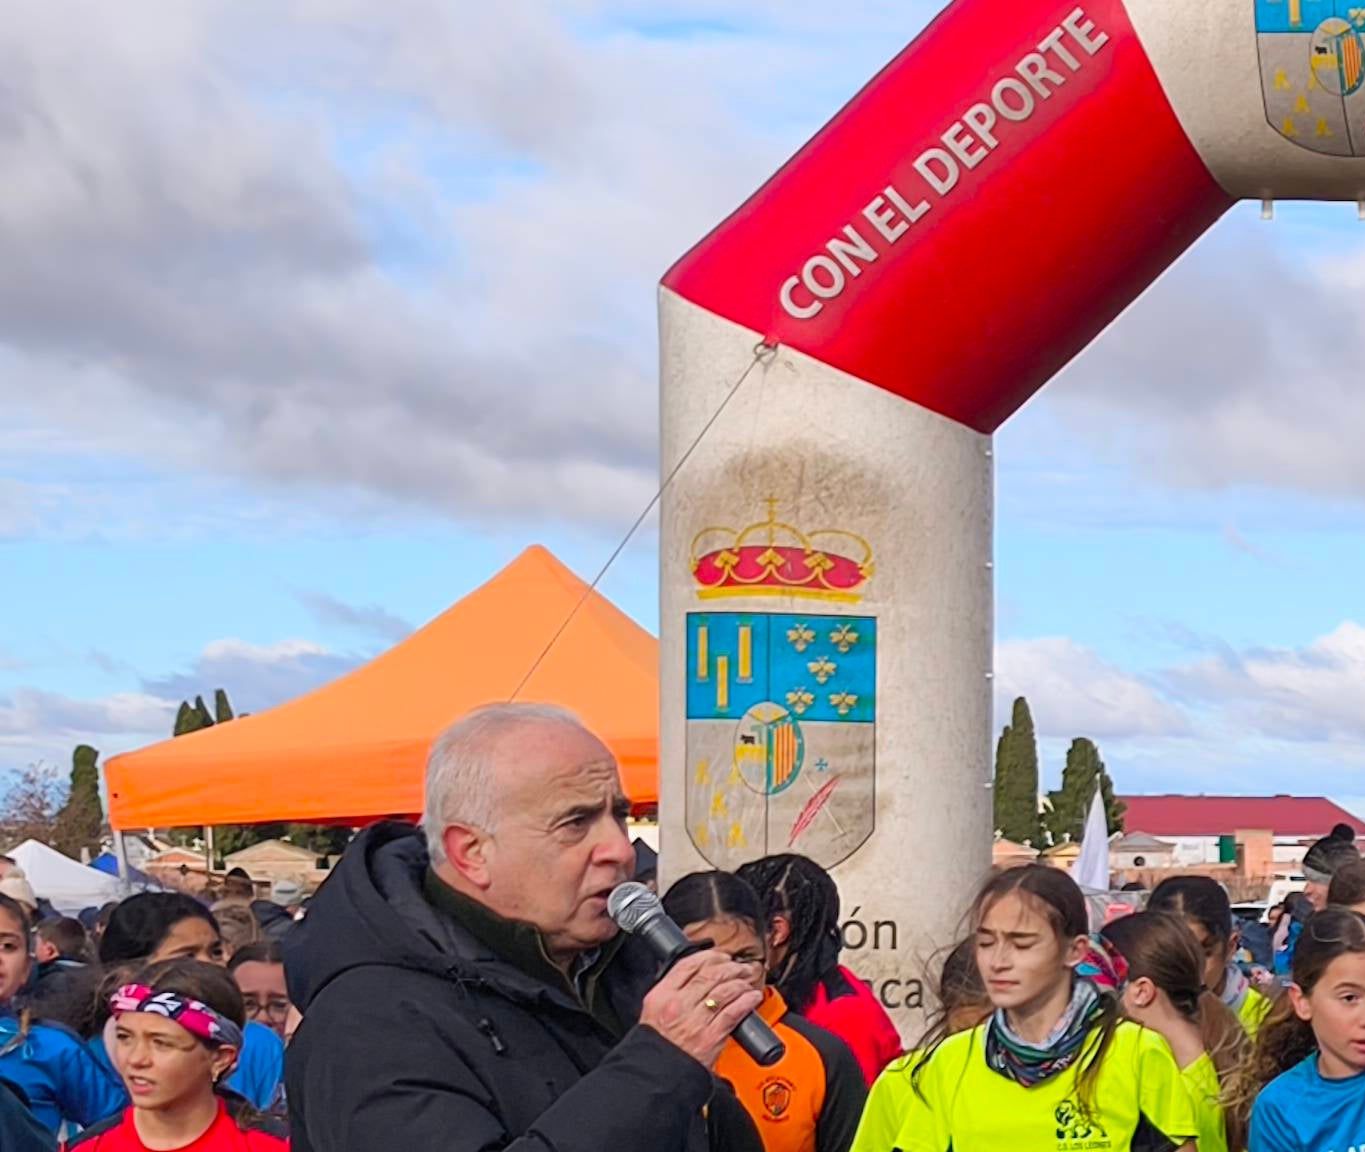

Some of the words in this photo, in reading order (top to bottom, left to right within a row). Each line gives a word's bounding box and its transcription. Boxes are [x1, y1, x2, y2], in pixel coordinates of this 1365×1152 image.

[779, 224, 878, 320] CON
[862, 185, 931, 243] EL
[912, 7, 1110, 196] DEPORTE
